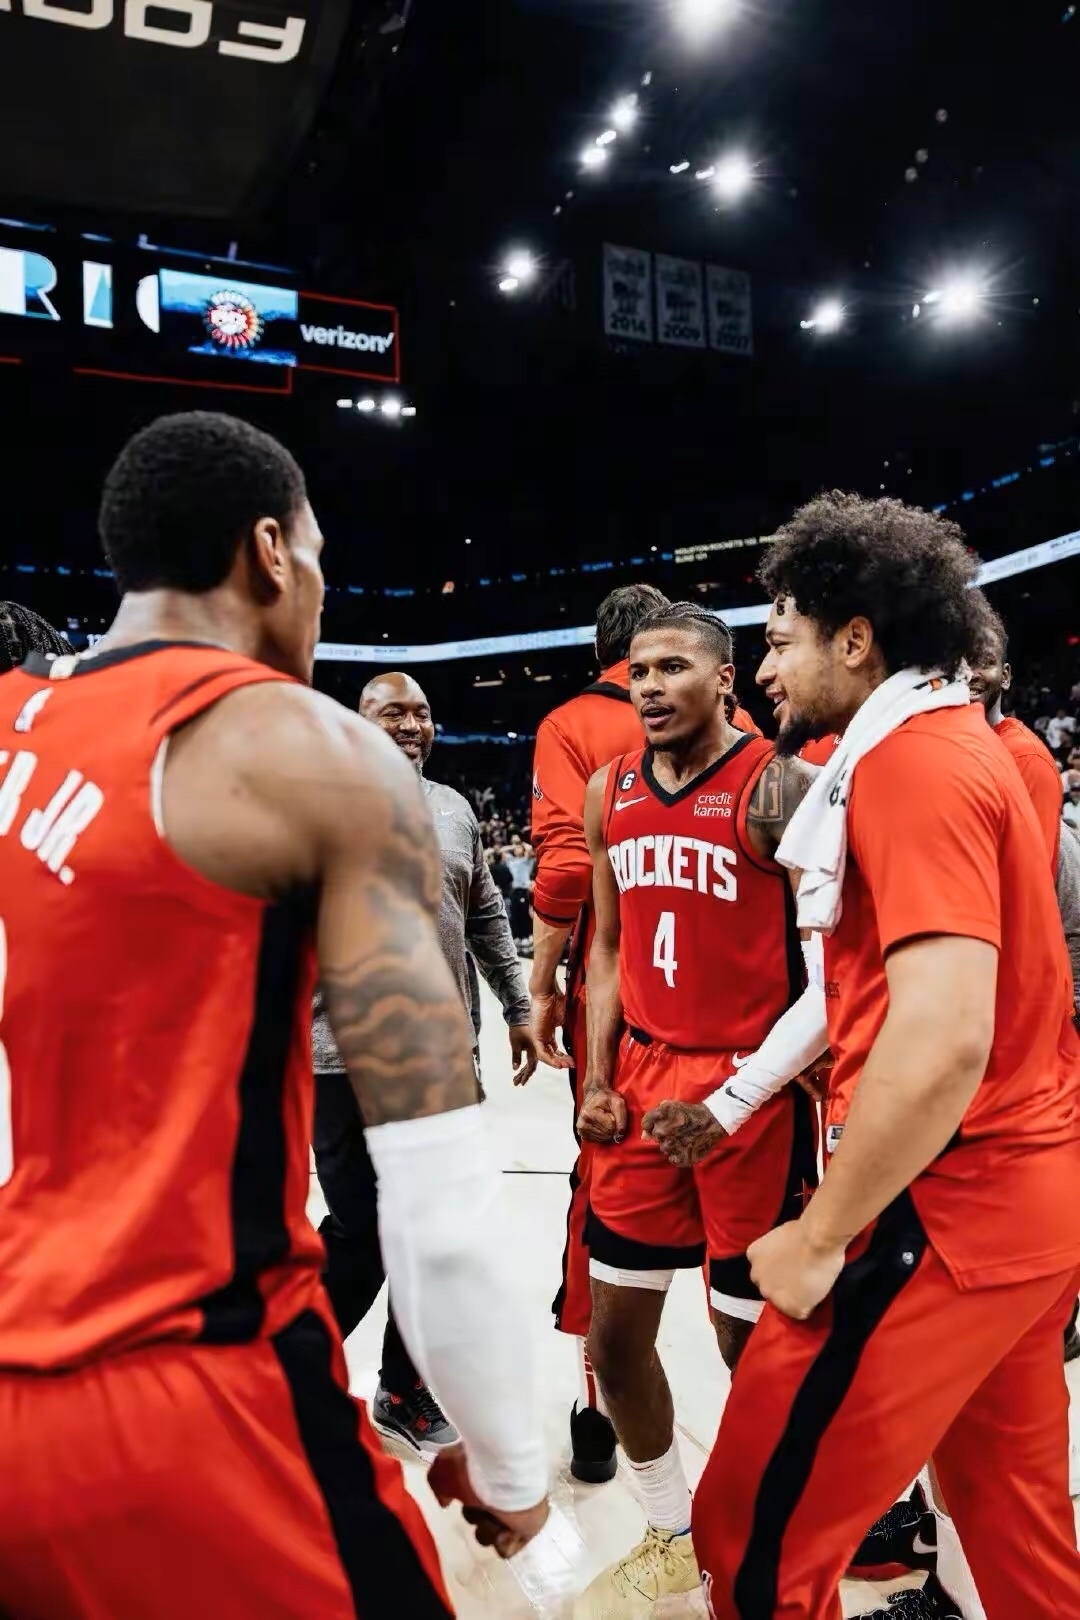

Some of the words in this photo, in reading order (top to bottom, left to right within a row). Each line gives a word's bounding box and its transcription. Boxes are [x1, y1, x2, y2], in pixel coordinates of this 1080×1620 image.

[0, 0, 306, 63] FOO
[610, 313, 646, 335] 2014
[301, 324, 386, 353] verizon
[621, 773, 635, 790] 6
[698, 793, 733, 805] credit
[693, 807, 732, 818] karma
[607, 834, 737, 902] ROCKETS
[653, 911, 678, 988] 4
